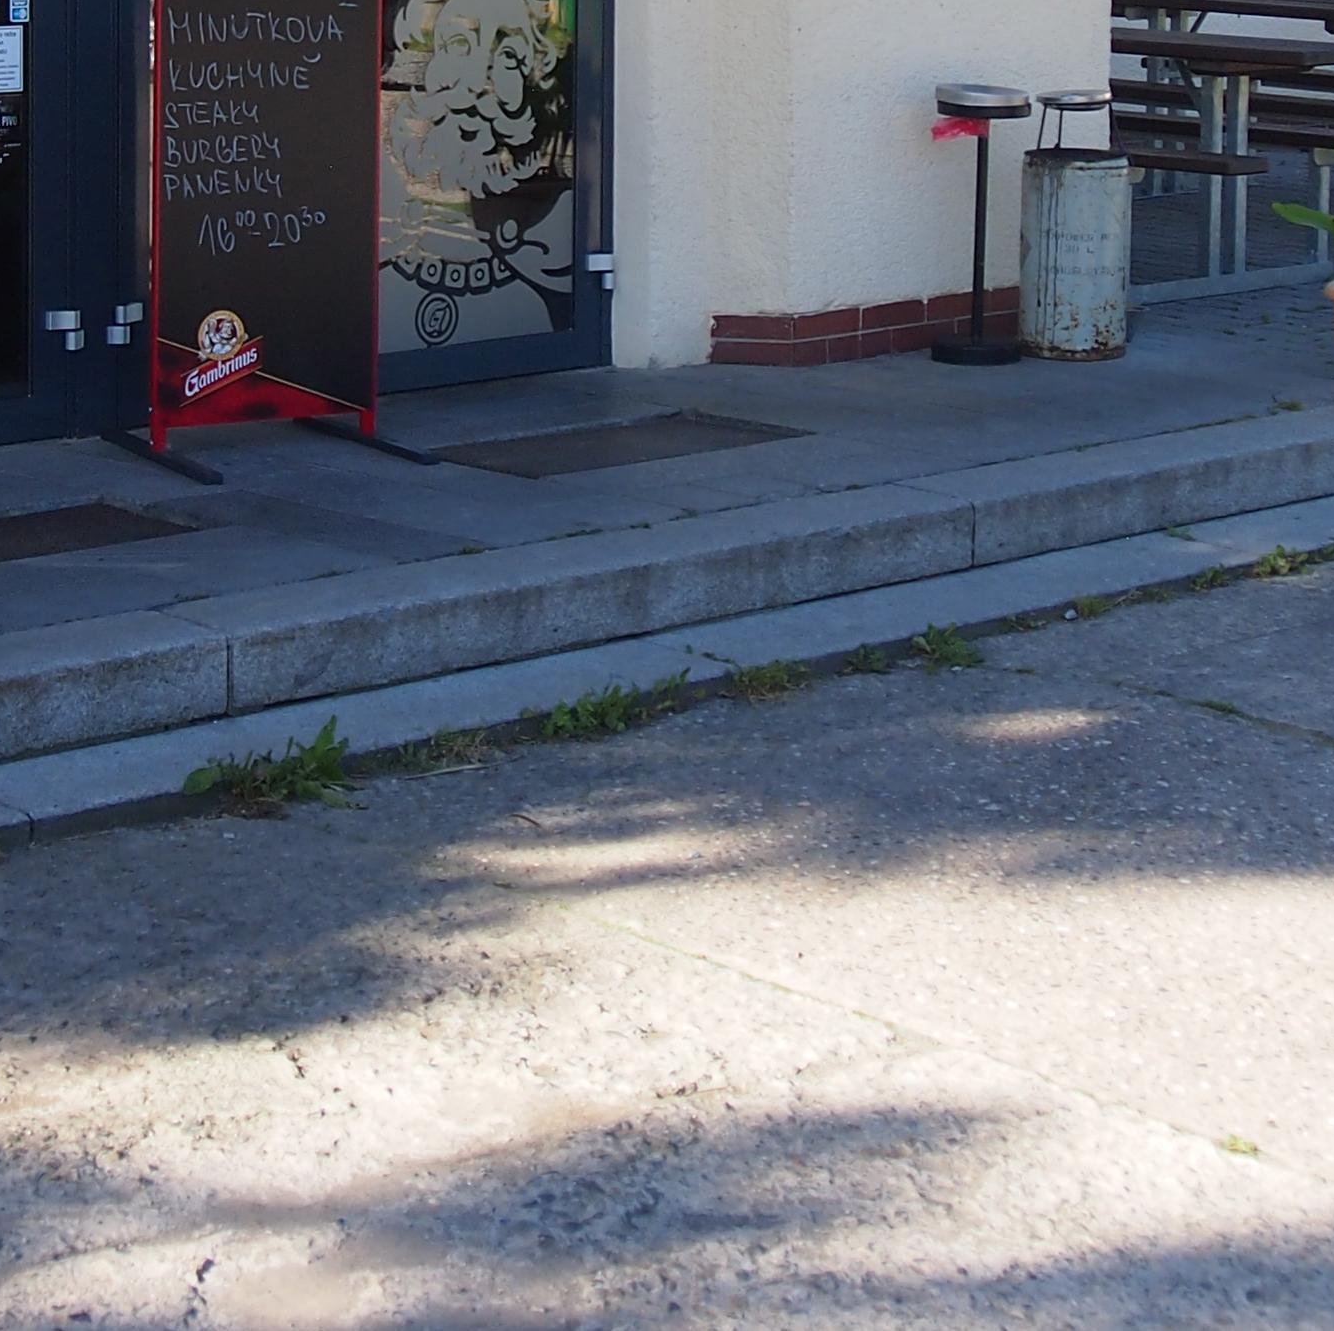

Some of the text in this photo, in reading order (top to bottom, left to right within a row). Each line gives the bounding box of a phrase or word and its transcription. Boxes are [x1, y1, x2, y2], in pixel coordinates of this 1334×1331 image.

[164, 135, 281, 167] BURGERY
[163, 169, 284, 202] PANENKY
[184, 347, 259, 398] Gambrinus
